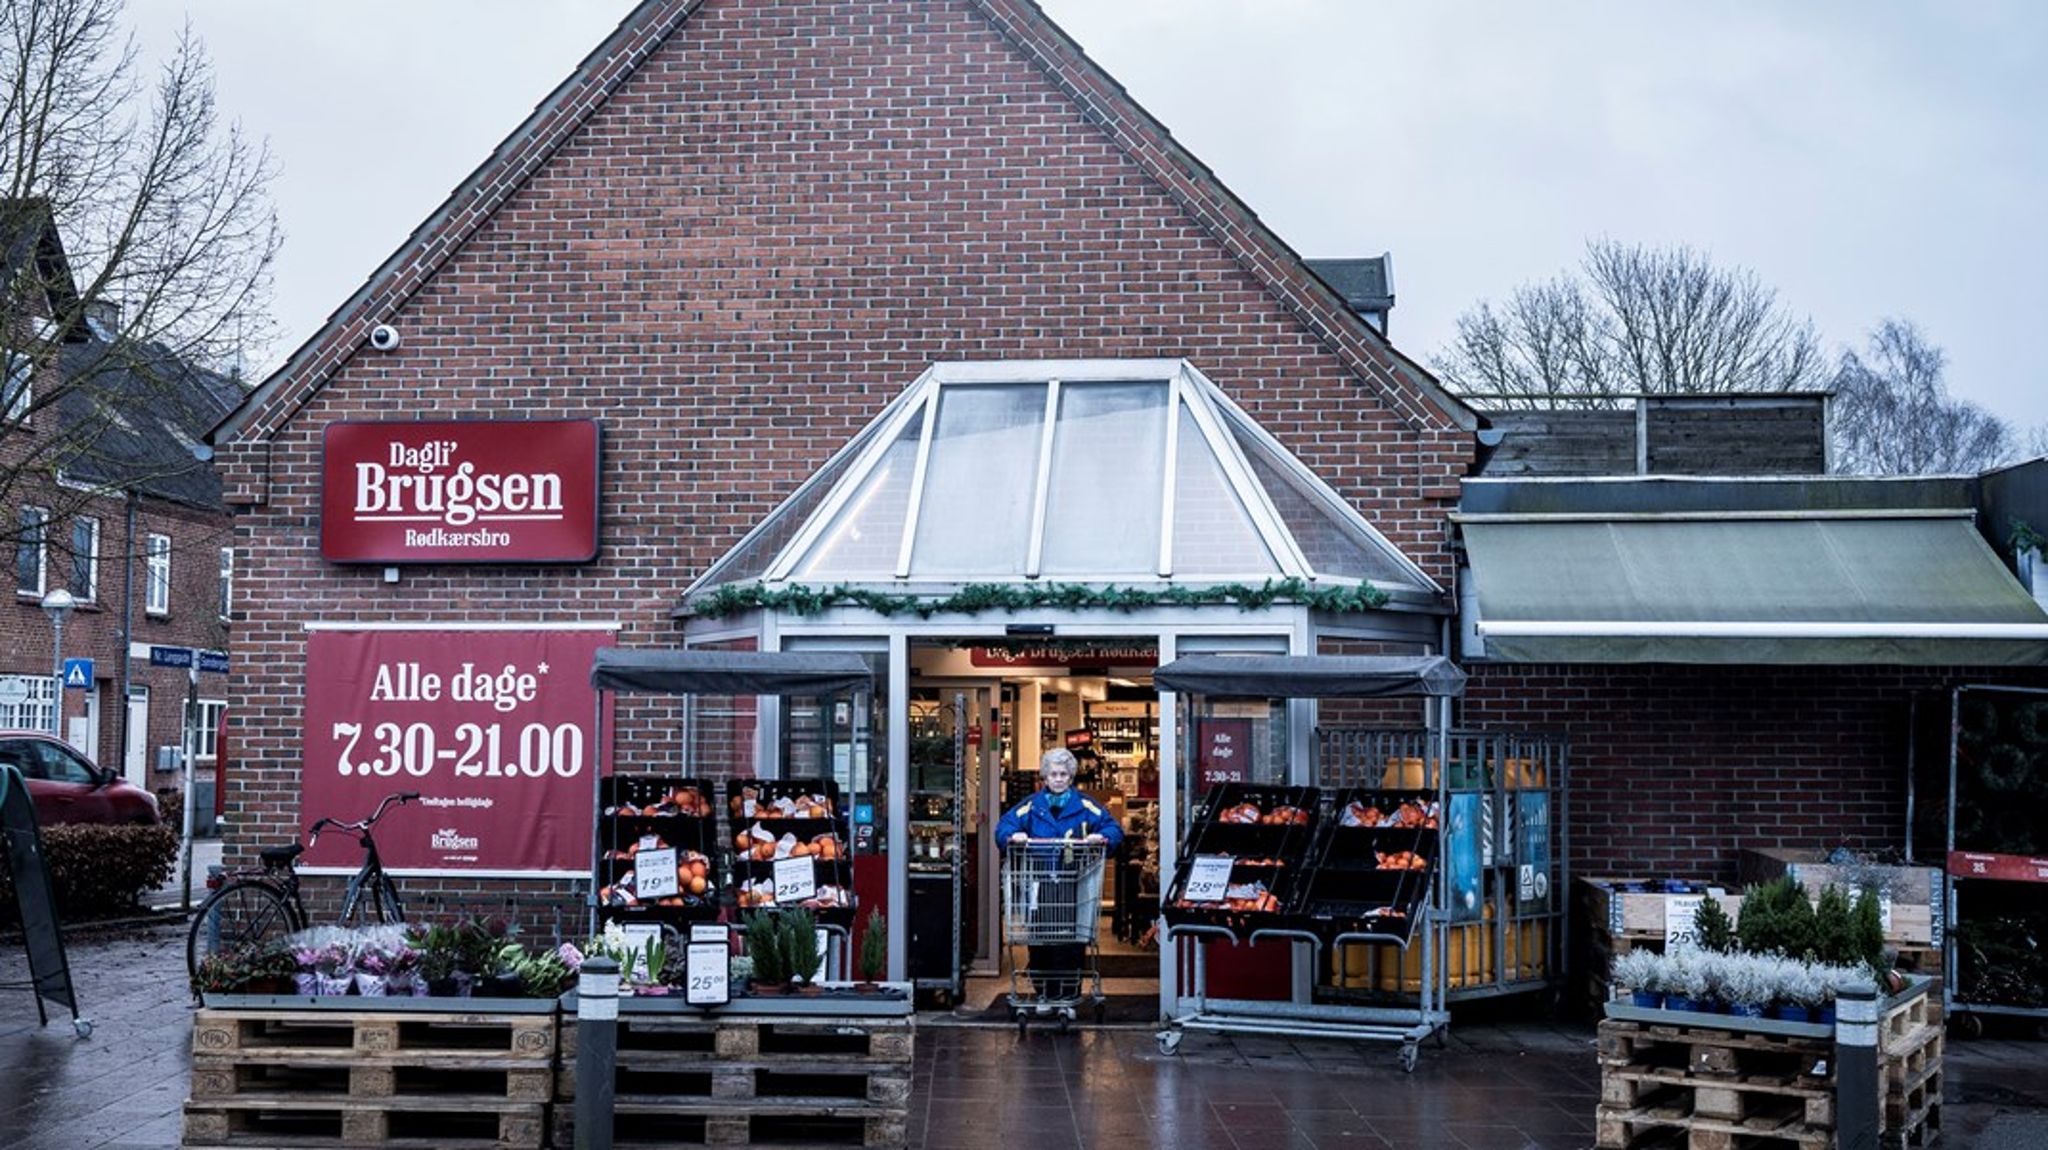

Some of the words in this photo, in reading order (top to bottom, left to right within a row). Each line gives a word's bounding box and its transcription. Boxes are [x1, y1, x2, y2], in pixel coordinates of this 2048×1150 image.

[389, 441, 458, 473] Dagli'
[354, 461, 564, 526] Brugsen
[404, 528, 511, 547] Rødkærsbro
[369, 662, 442, 701] Alle
[332, 722, 584, 778] 7.30-21.00
[1214, 733, 1232, 743] Alle
[1212, 747, 1234, 758] dage
[431, 833, 479, 850] Brugsen
